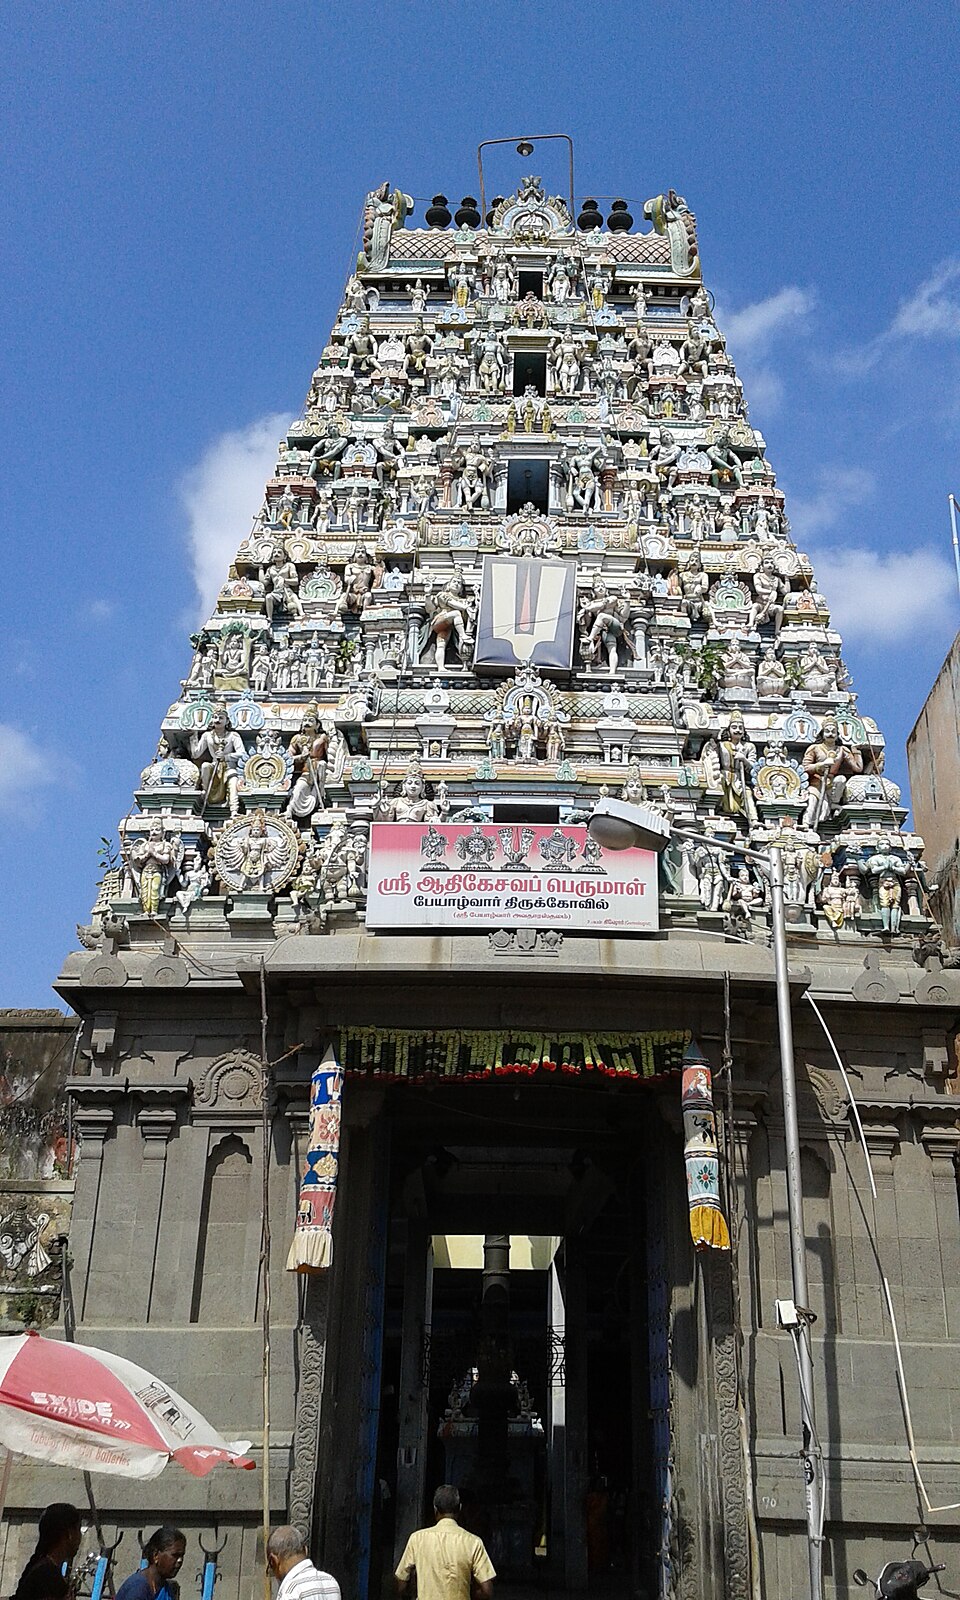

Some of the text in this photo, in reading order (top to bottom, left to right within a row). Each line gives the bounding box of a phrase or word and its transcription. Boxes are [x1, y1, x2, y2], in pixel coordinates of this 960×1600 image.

[417, 874, 541, 896] ஆதிகேசவப்
[547, 878, 646, 897] பெருமாள்
[413, 896, 609, 910] பேயாழ்வார் திருக்கோவில்
